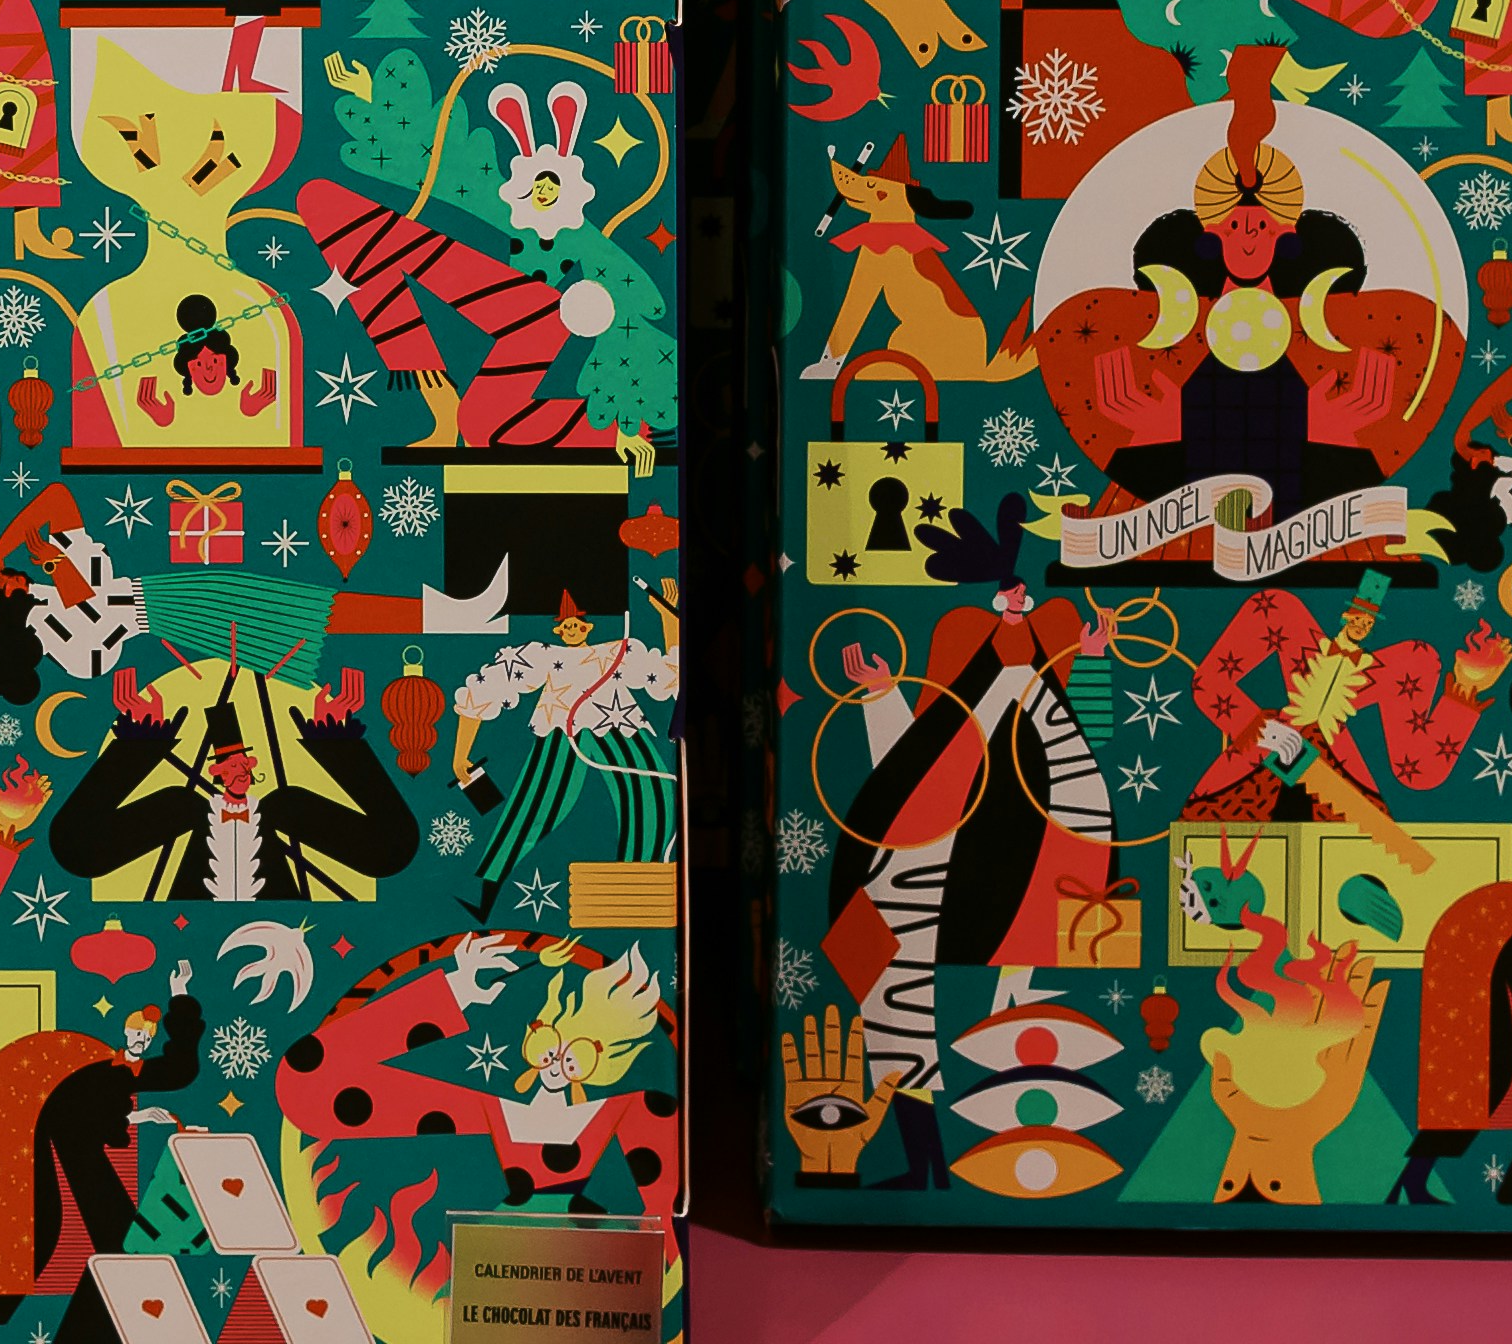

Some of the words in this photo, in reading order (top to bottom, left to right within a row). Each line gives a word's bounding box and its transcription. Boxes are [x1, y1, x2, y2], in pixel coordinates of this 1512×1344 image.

[1098, 520, 1138, 560] UN
[1146, 485, 1211, 547] NOËL
[474, 1263, 562, 1282] CALENDRIER
[566, 1267, 585, 1283] DE
[462, 1305, 479, 1323] LE
[482, 1305, 551, 1327] CHOCOLAT
[555, 1309, 582, 1327] DES
[585, 1311, 652, 1332] FRANÇAIS
